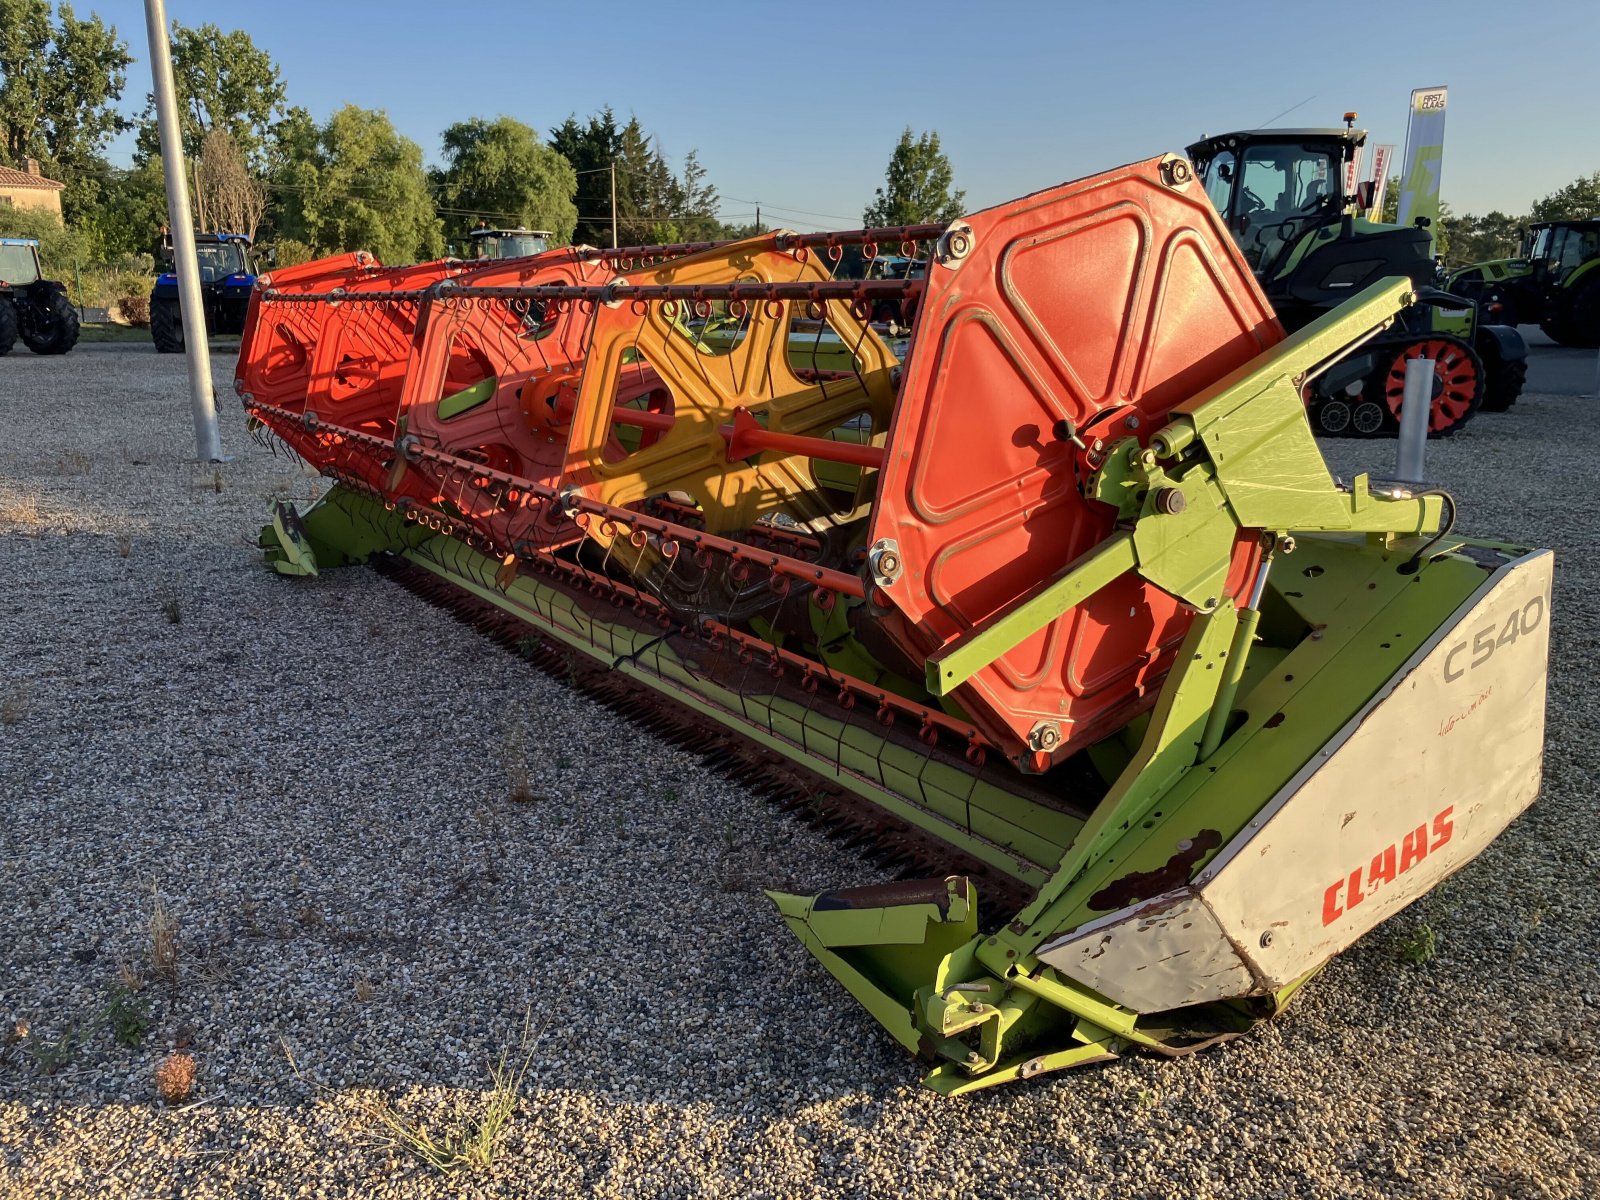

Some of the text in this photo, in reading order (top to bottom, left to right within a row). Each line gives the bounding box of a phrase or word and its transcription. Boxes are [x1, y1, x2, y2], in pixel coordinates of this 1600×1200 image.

[1422, 101, 1445, 109] CLAAS
[1423, 94, 1442, 102] FIRST
[1444, 595, 1544, 684] C 540
[1322, 805, 1454, 927] CLAAS
